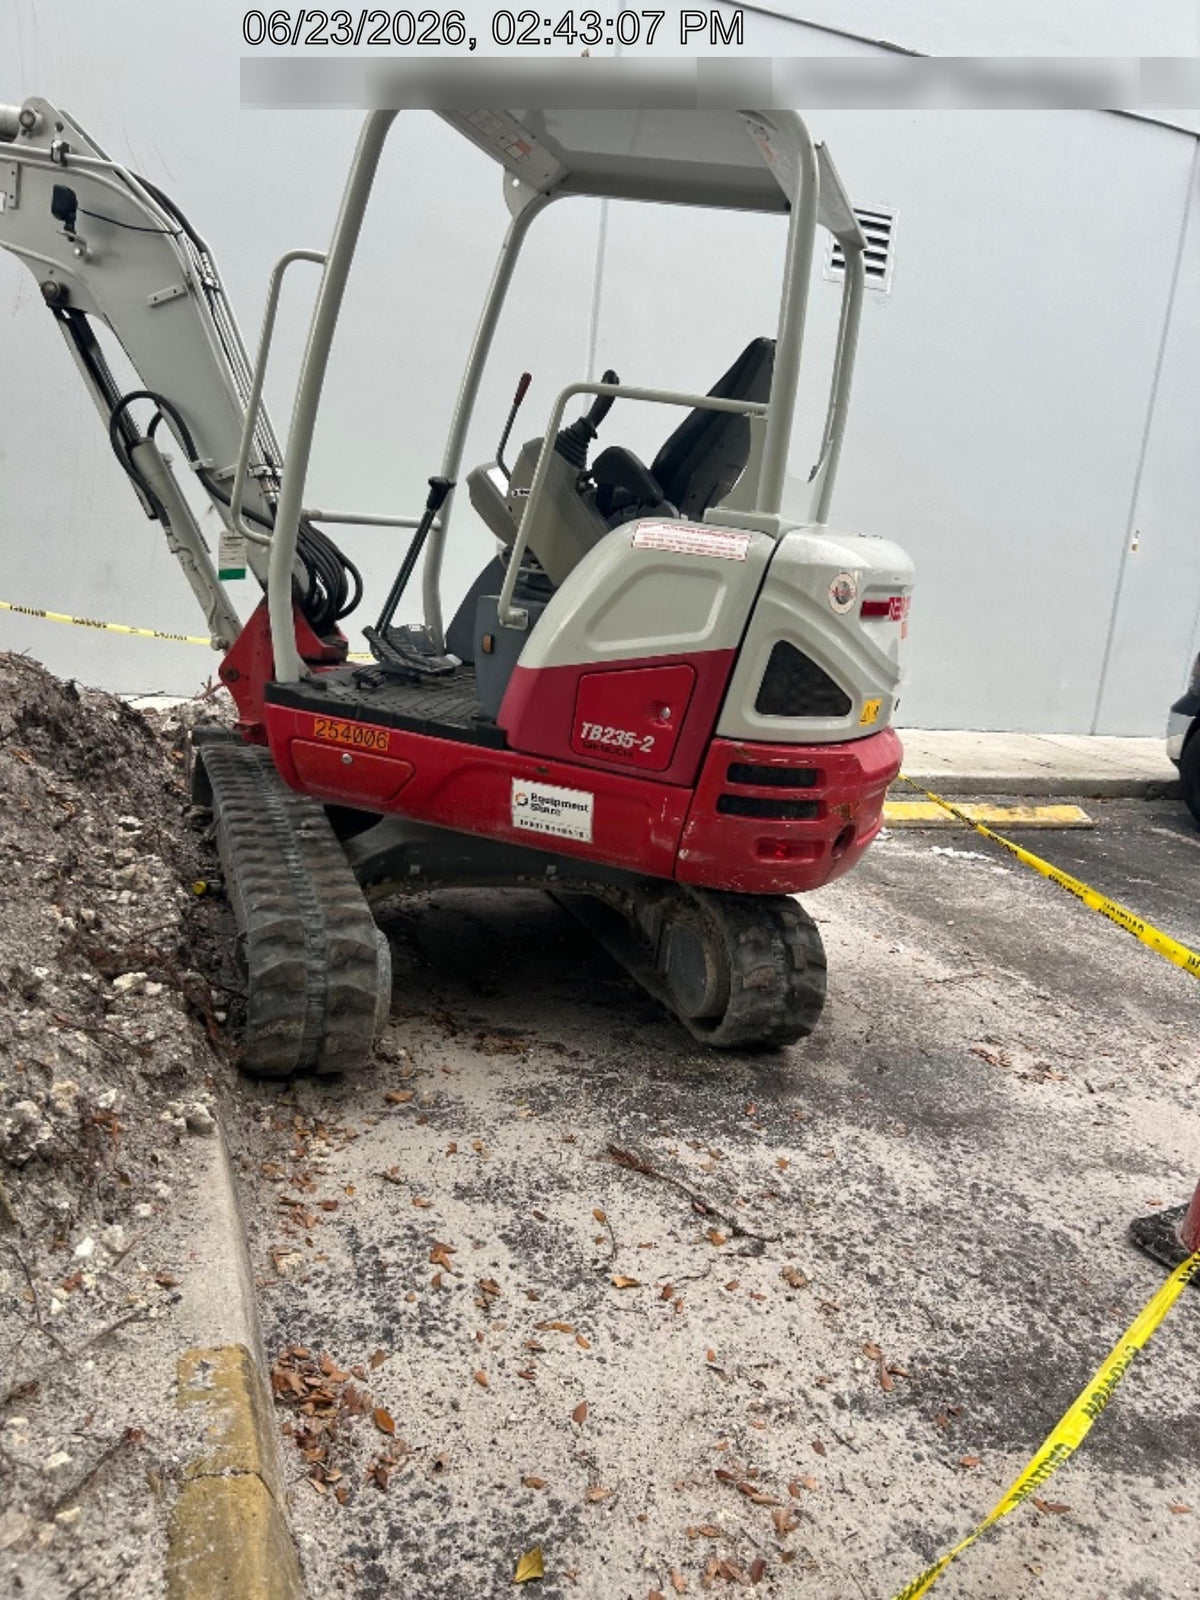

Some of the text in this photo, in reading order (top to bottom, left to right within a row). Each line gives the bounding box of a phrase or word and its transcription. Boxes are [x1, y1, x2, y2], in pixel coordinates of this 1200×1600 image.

[315, 719, 388, 749] 254006
[580, 721, 655, 753] TB235-2
[530, 792, 589, 813] Equipment
